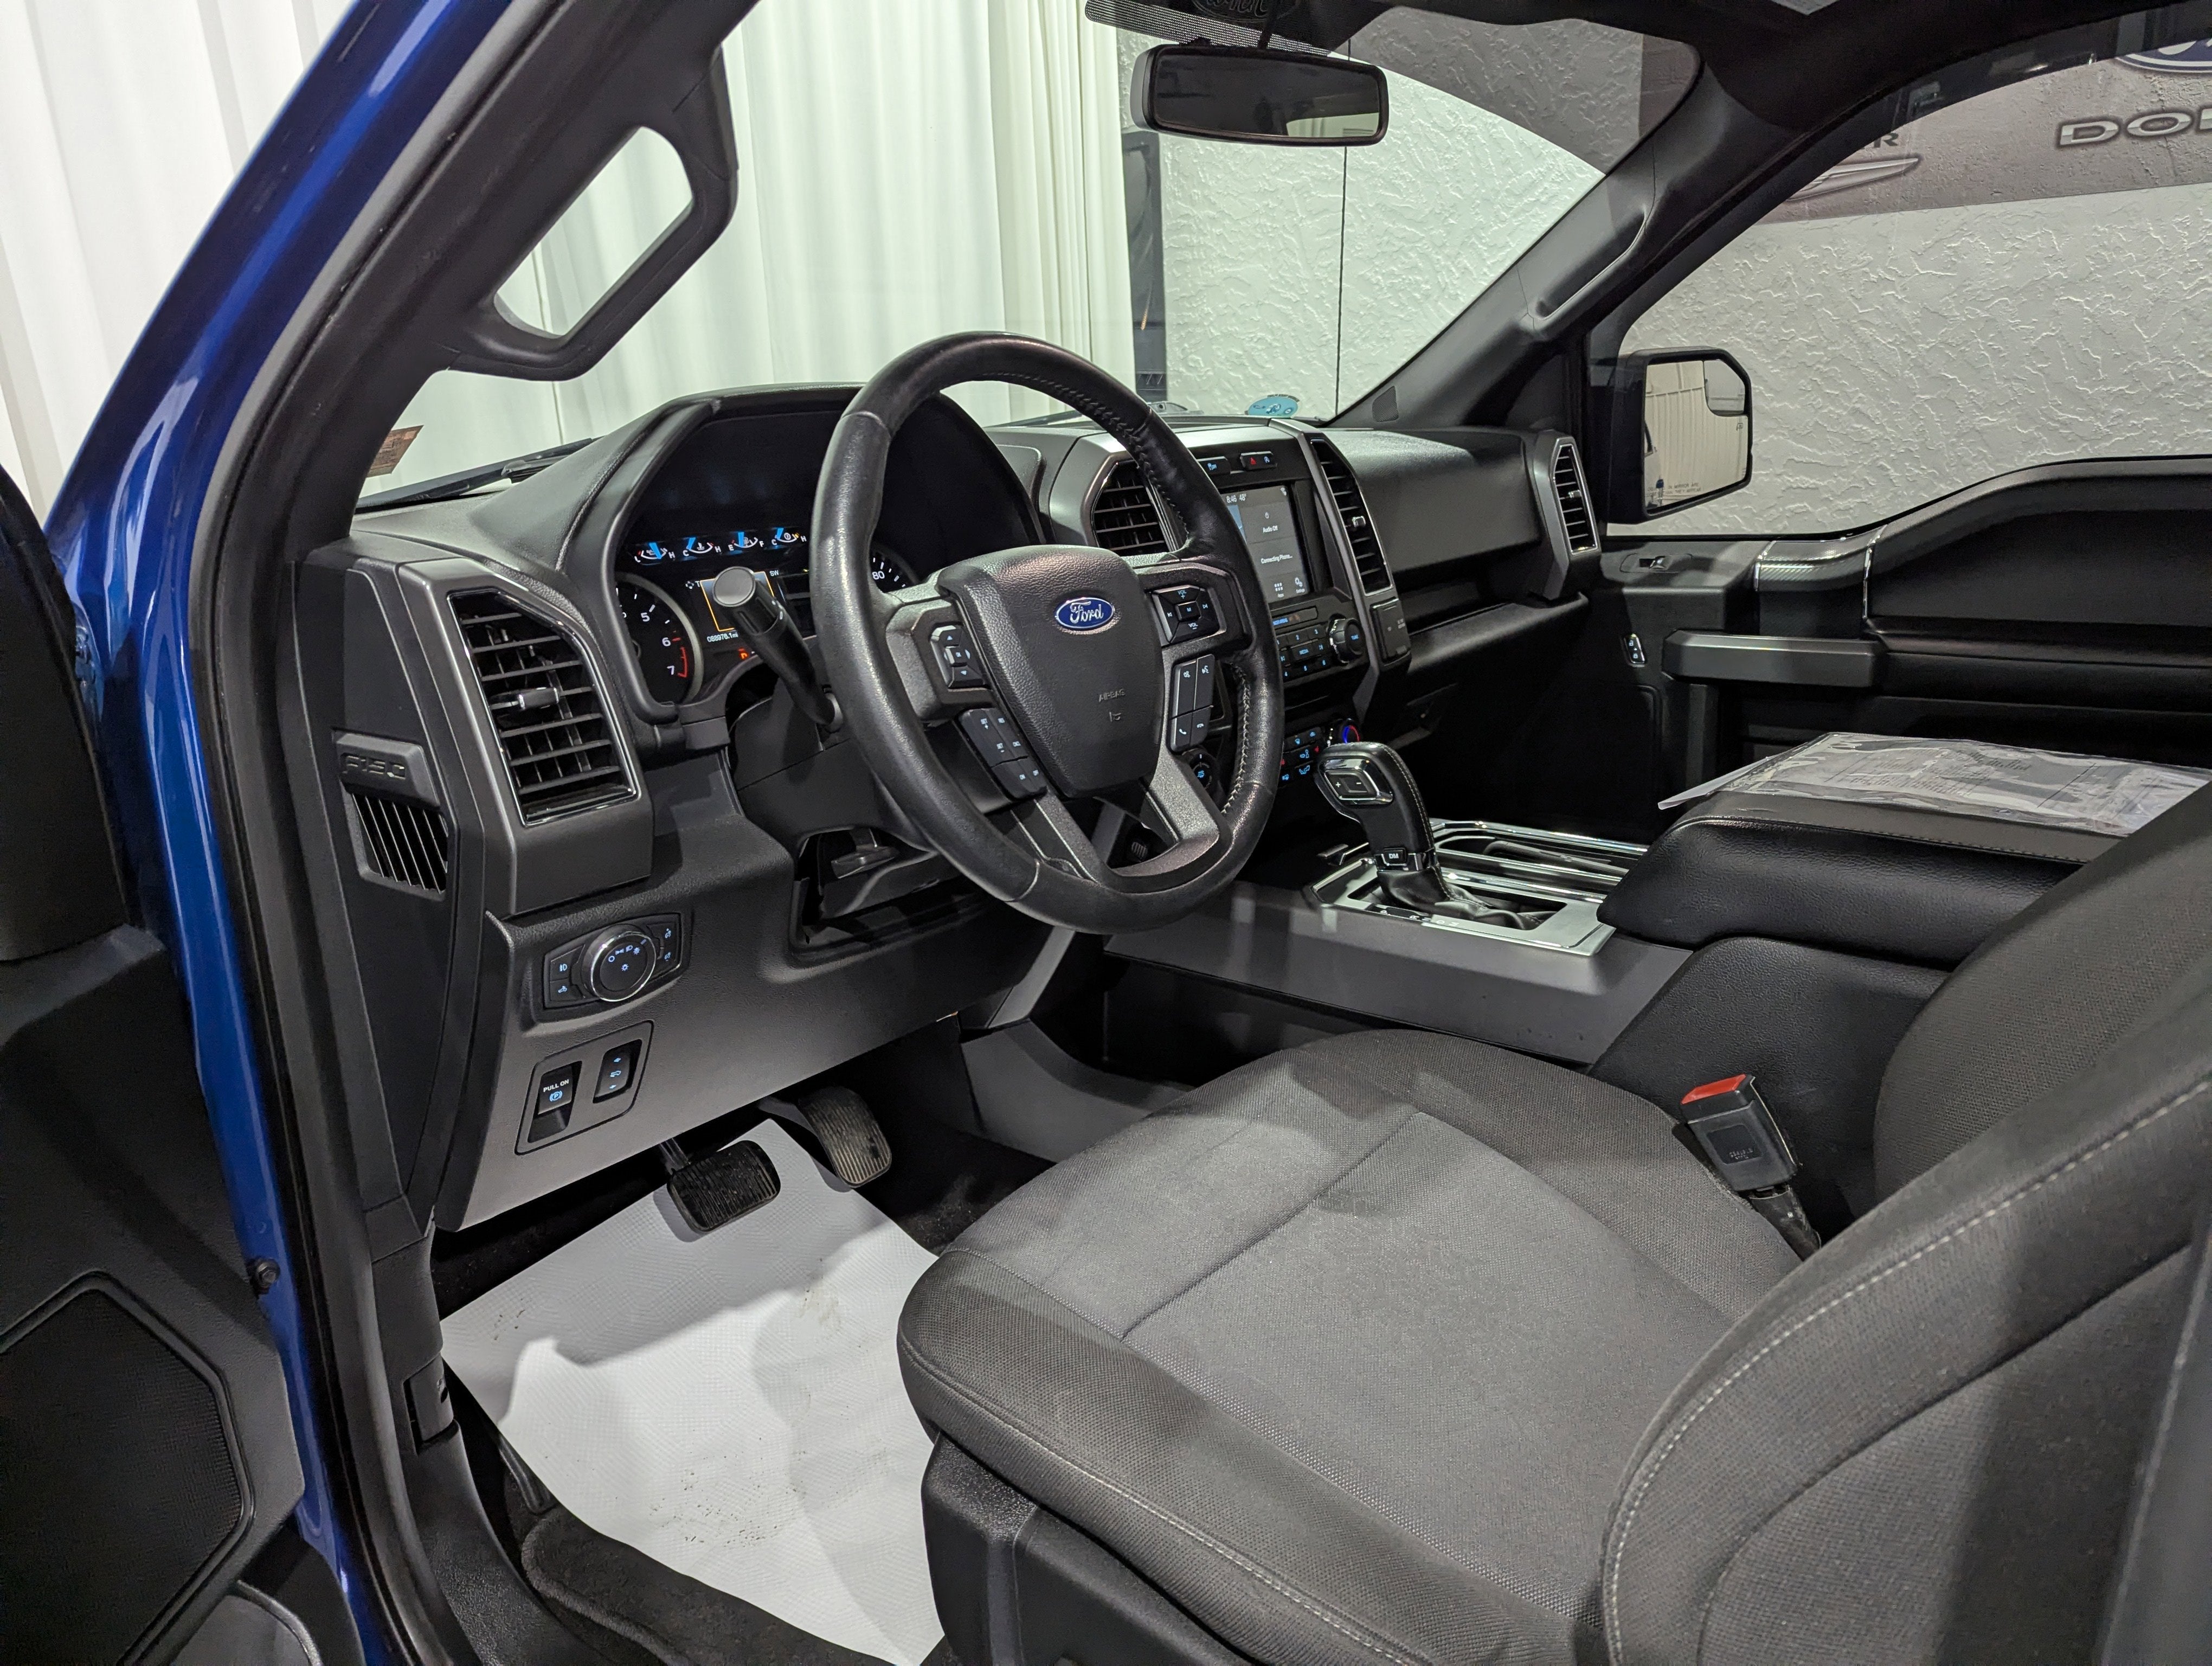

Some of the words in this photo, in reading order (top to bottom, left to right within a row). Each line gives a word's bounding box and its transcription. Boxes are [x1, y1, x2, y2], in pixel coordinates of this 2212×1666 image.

[1226, 495, 1237, 503] 8:46
[1261, 555, 1279, 565] Connecting
[872, 571, 885, 580] 80
[640, 612, 650, 622] 5
[1070, 601, 1104, 624] Ford
[662, 637, 671, 647] 6
[667, 665, 675, 675] 7
[1098, 689, 1126, 702] AIRBAG
[543, 1084, 560, 1093] PULL
